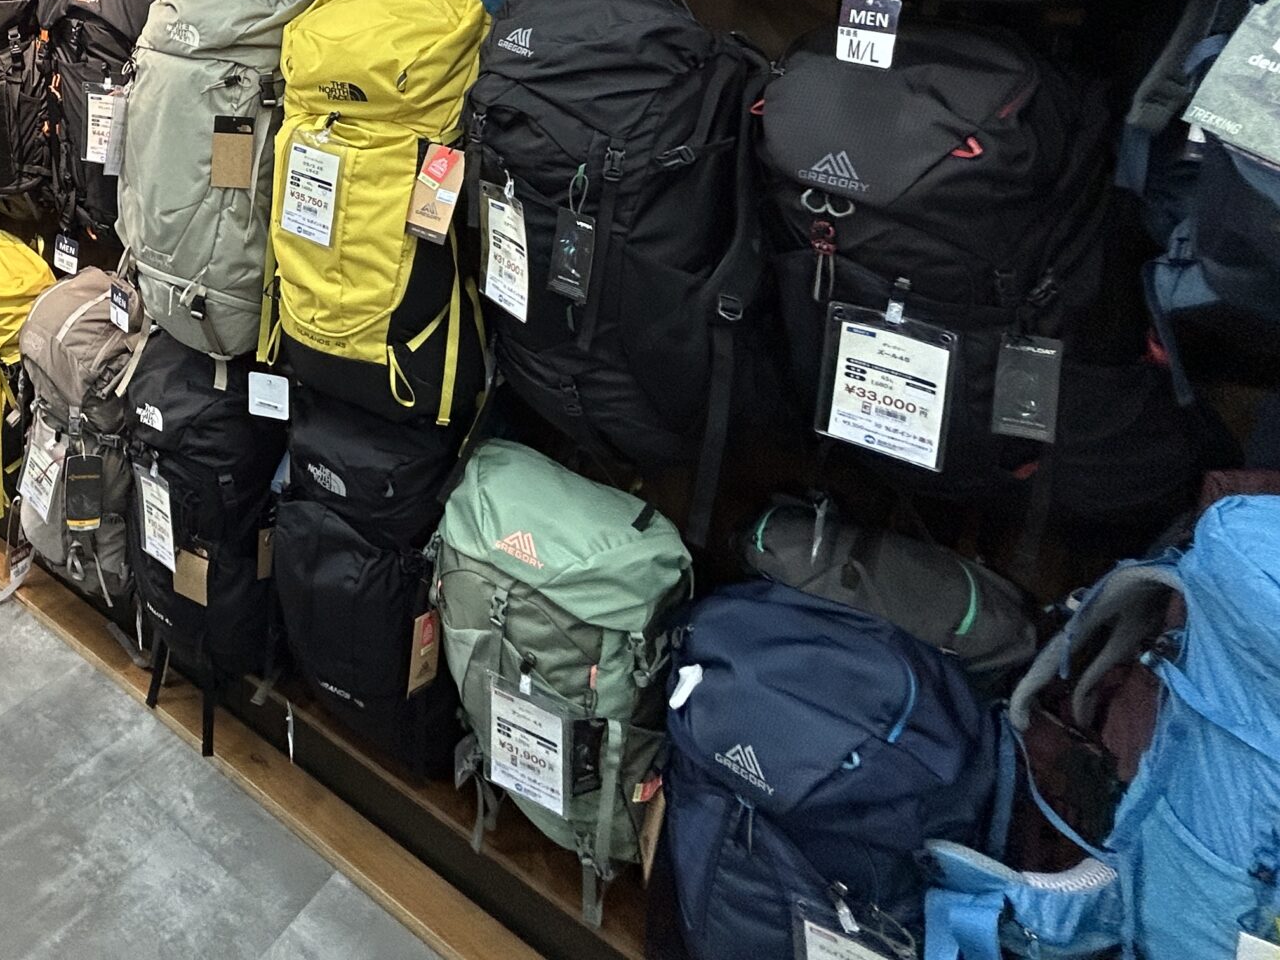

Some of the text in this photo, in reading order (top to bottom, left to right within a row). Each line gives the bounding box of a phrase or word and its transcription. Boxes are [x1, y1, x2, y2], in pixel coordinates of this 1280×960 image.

[849, 9, 889, 28] MEN
[498, 38, 534, 58] GREGORY
[847, 38, 879, 64] M/L
[319, 85, 348, 96] NORTH
[331, 81, 348, 89] THE
[1189, 105, 1243, 135] TREKKING
[798, 168, 870, 192] GREGORY
[60, 242, 75, 255] MEN
[113, 293, 127, 309] MEN
[845, 383, 917, 414] ¥33,000
[496, 540, 544, 570] GREGORY
[714, 752, 774, 796] GREGORY
